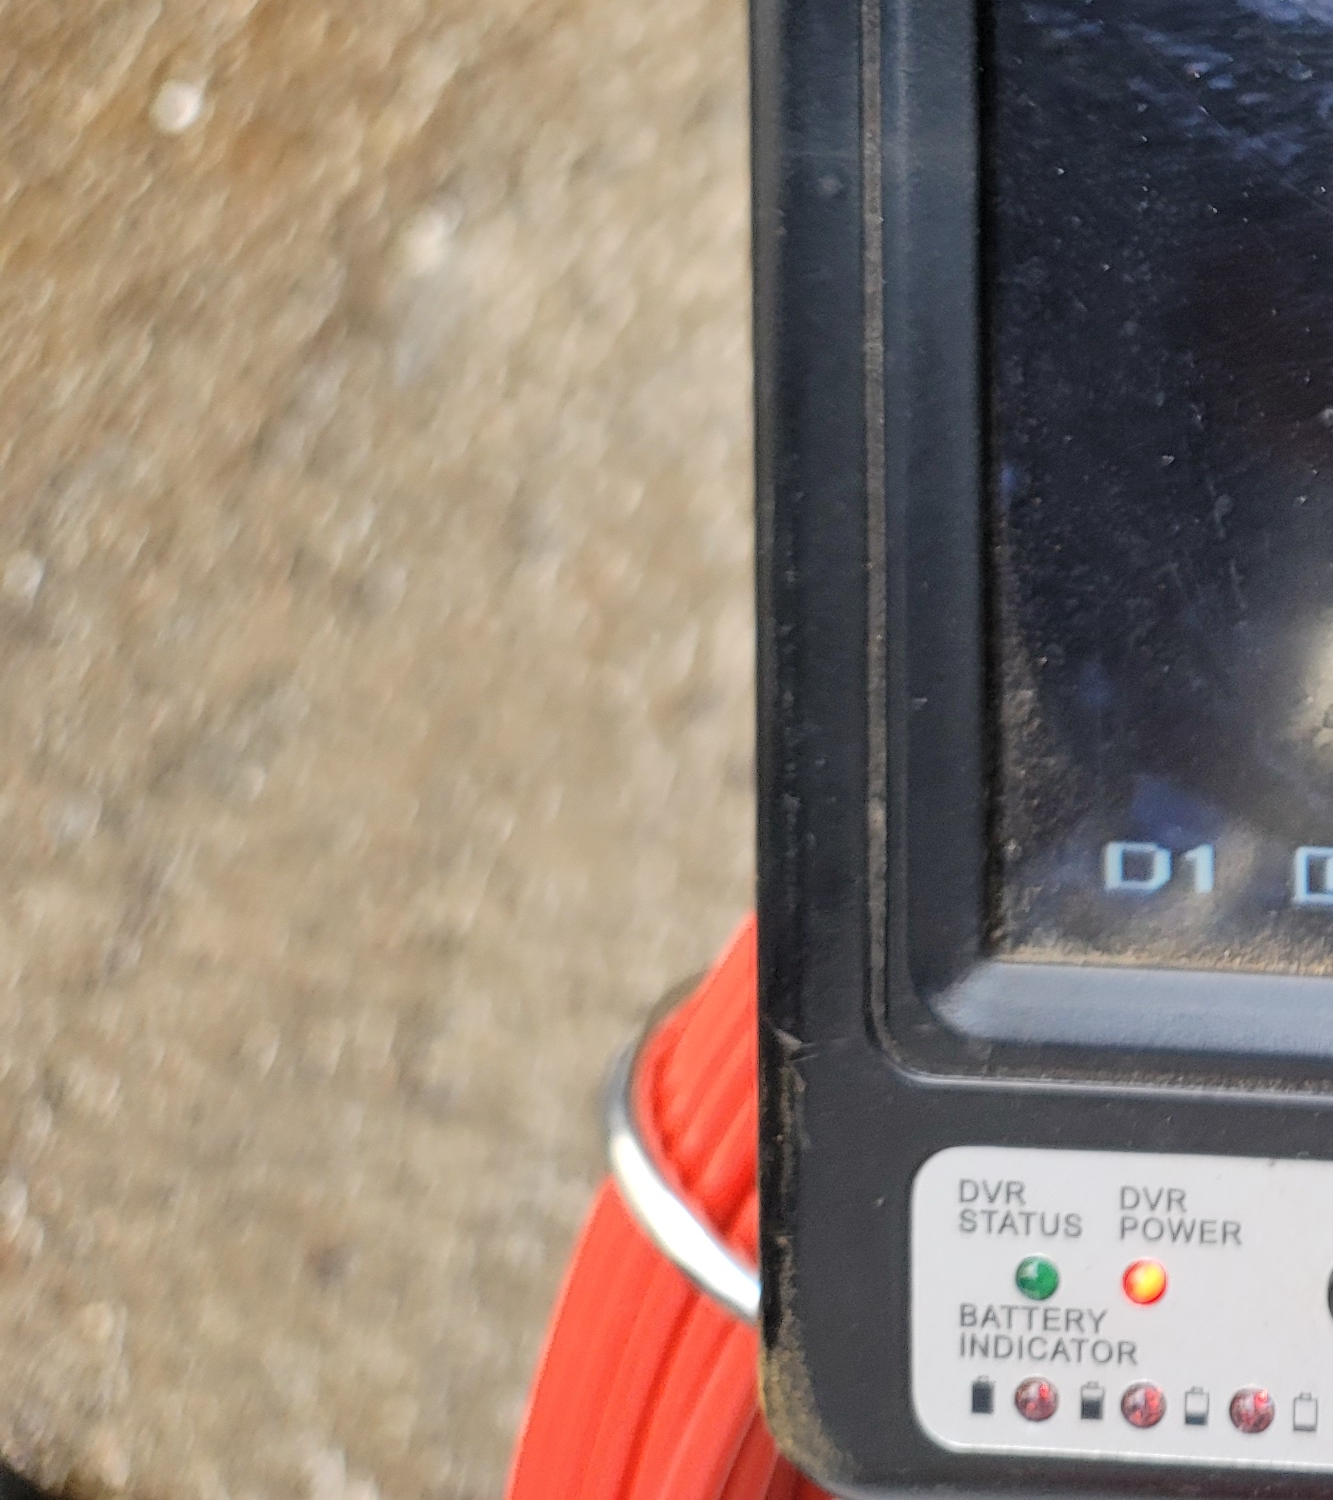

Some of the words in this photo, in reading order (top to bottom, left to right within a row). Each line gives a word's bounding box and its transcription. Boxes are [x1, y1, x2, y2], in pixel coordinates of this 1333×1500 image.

[1103, 840, 1214, 895] D1
[958, 1178, 1026, 1206] DVR
[1118, 1185, 1187, 1214] DVR
[958, 1208, 1083, 1239] STATUS
[1118, 1215, 1243, 1247] POWER
[958, 1303, 1109, 1334] BATTERY
[958, 1334, 1139, 1367] INDICATOR
